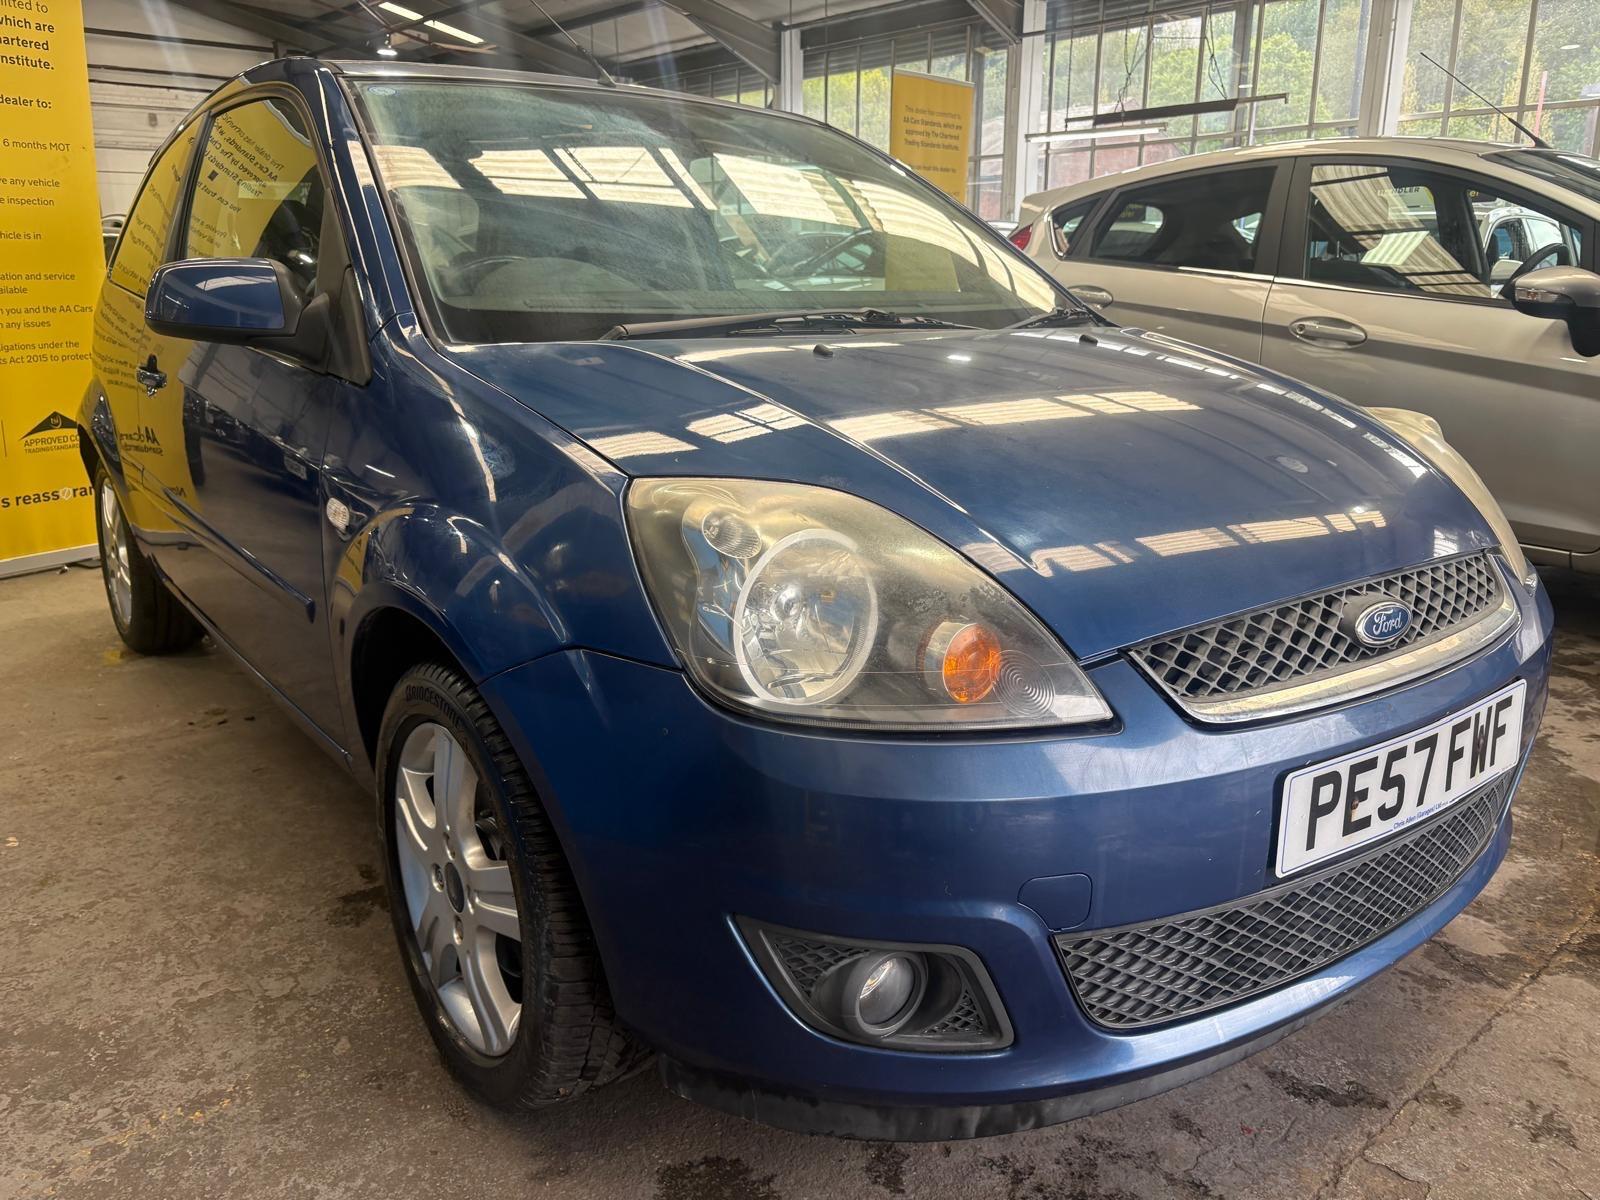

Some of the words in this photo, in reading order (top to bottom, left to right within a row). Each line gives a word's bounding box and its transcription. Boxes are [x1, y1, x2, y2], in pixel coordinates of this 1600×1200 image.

[36, 2, 48, 13] to
[35, 22, 55, 33] are
[0, 94, 33, 107] dealer
[36, 98, 52, 109] to:
[3, 138, 10, 147] 6
[12, 141, 47, 150] months
[49, 142, 71, 152] MOT
[10, 178, 25, 187] any
[27, 178, 61, 188] vehicle
[7, 195, 55, 206] inspection
[23, 231, 32, 240] is
[33, 231, 42, 240] in
[25, 271, 42, 281] and
[43, 272, 76, 281] service
[5, 307, 22, 316] you
[24, 305, 41, 314] and
[43, 304, 57, 313] the
[59, 305, 72, 313] AA
[73, 304, 94, 313] Cars
[5, 321, 21, 331] any
[23, 319, 52, 328] issues
[37, 341, 64, 350] under
[65, 340, 80, 349] the
[9, 355, 25, 364] Act
[26, 353, 48, 363] 2015
[50, 353, 60, 362] to
[61, 351, 92, 363] protect
[24, 434, 69, 448] APPROVED
[1373, 609, 1403, 635] Ford
[405, 684, 461, 730] BRIDGESTONE
[1305, 732, 1438, 852] PE57
[1445, 694, 1513, 793] FWF
